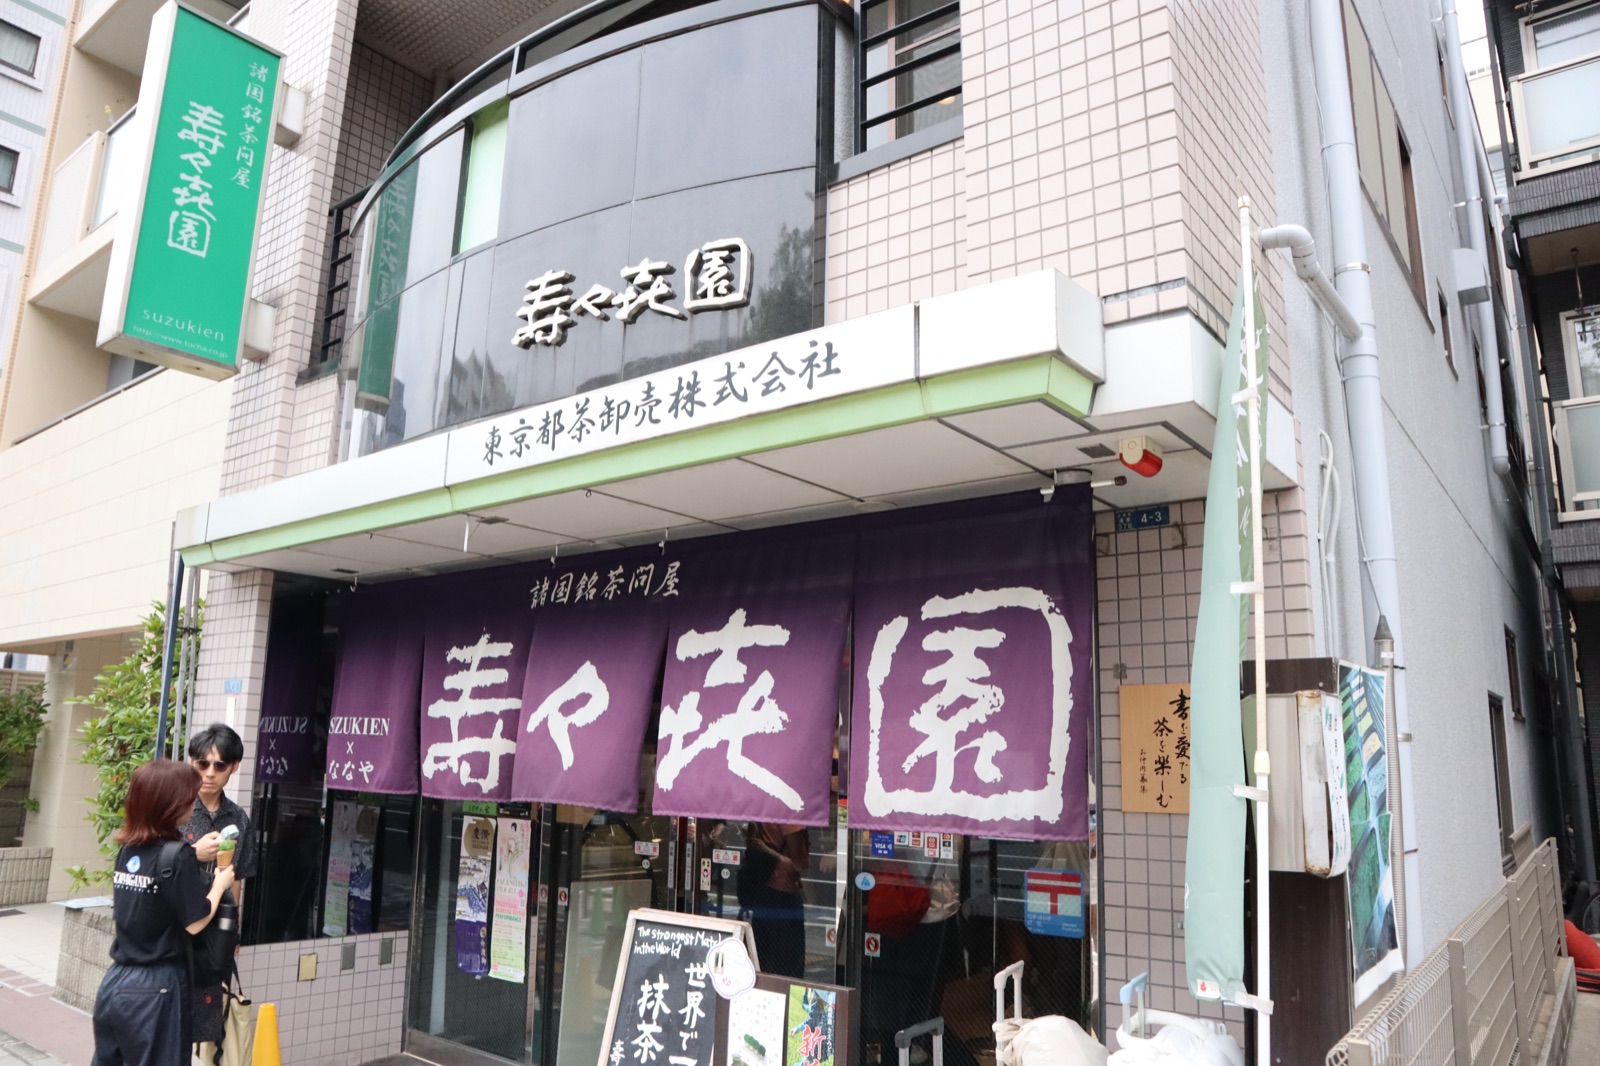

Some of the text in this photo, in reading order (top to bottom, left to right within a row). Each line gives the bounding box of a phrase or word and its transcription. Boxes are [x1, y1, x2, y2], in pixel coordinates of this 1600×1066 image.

[230, 61, 270, 189] 諸国銘茶問屋
[143, 309, 225, 342] suzukien
[482, 340, 842, 467] 東京都茶卸売株式会社
[1141, 511, 1162, 524] 4-3
[530, 560, 681, 609] 諸国銘茶問屋
[328, 759, 374, 784] ななや
[652, 928, 694, 946] strongest
[631, 973, 671, 1064] 抹茶
